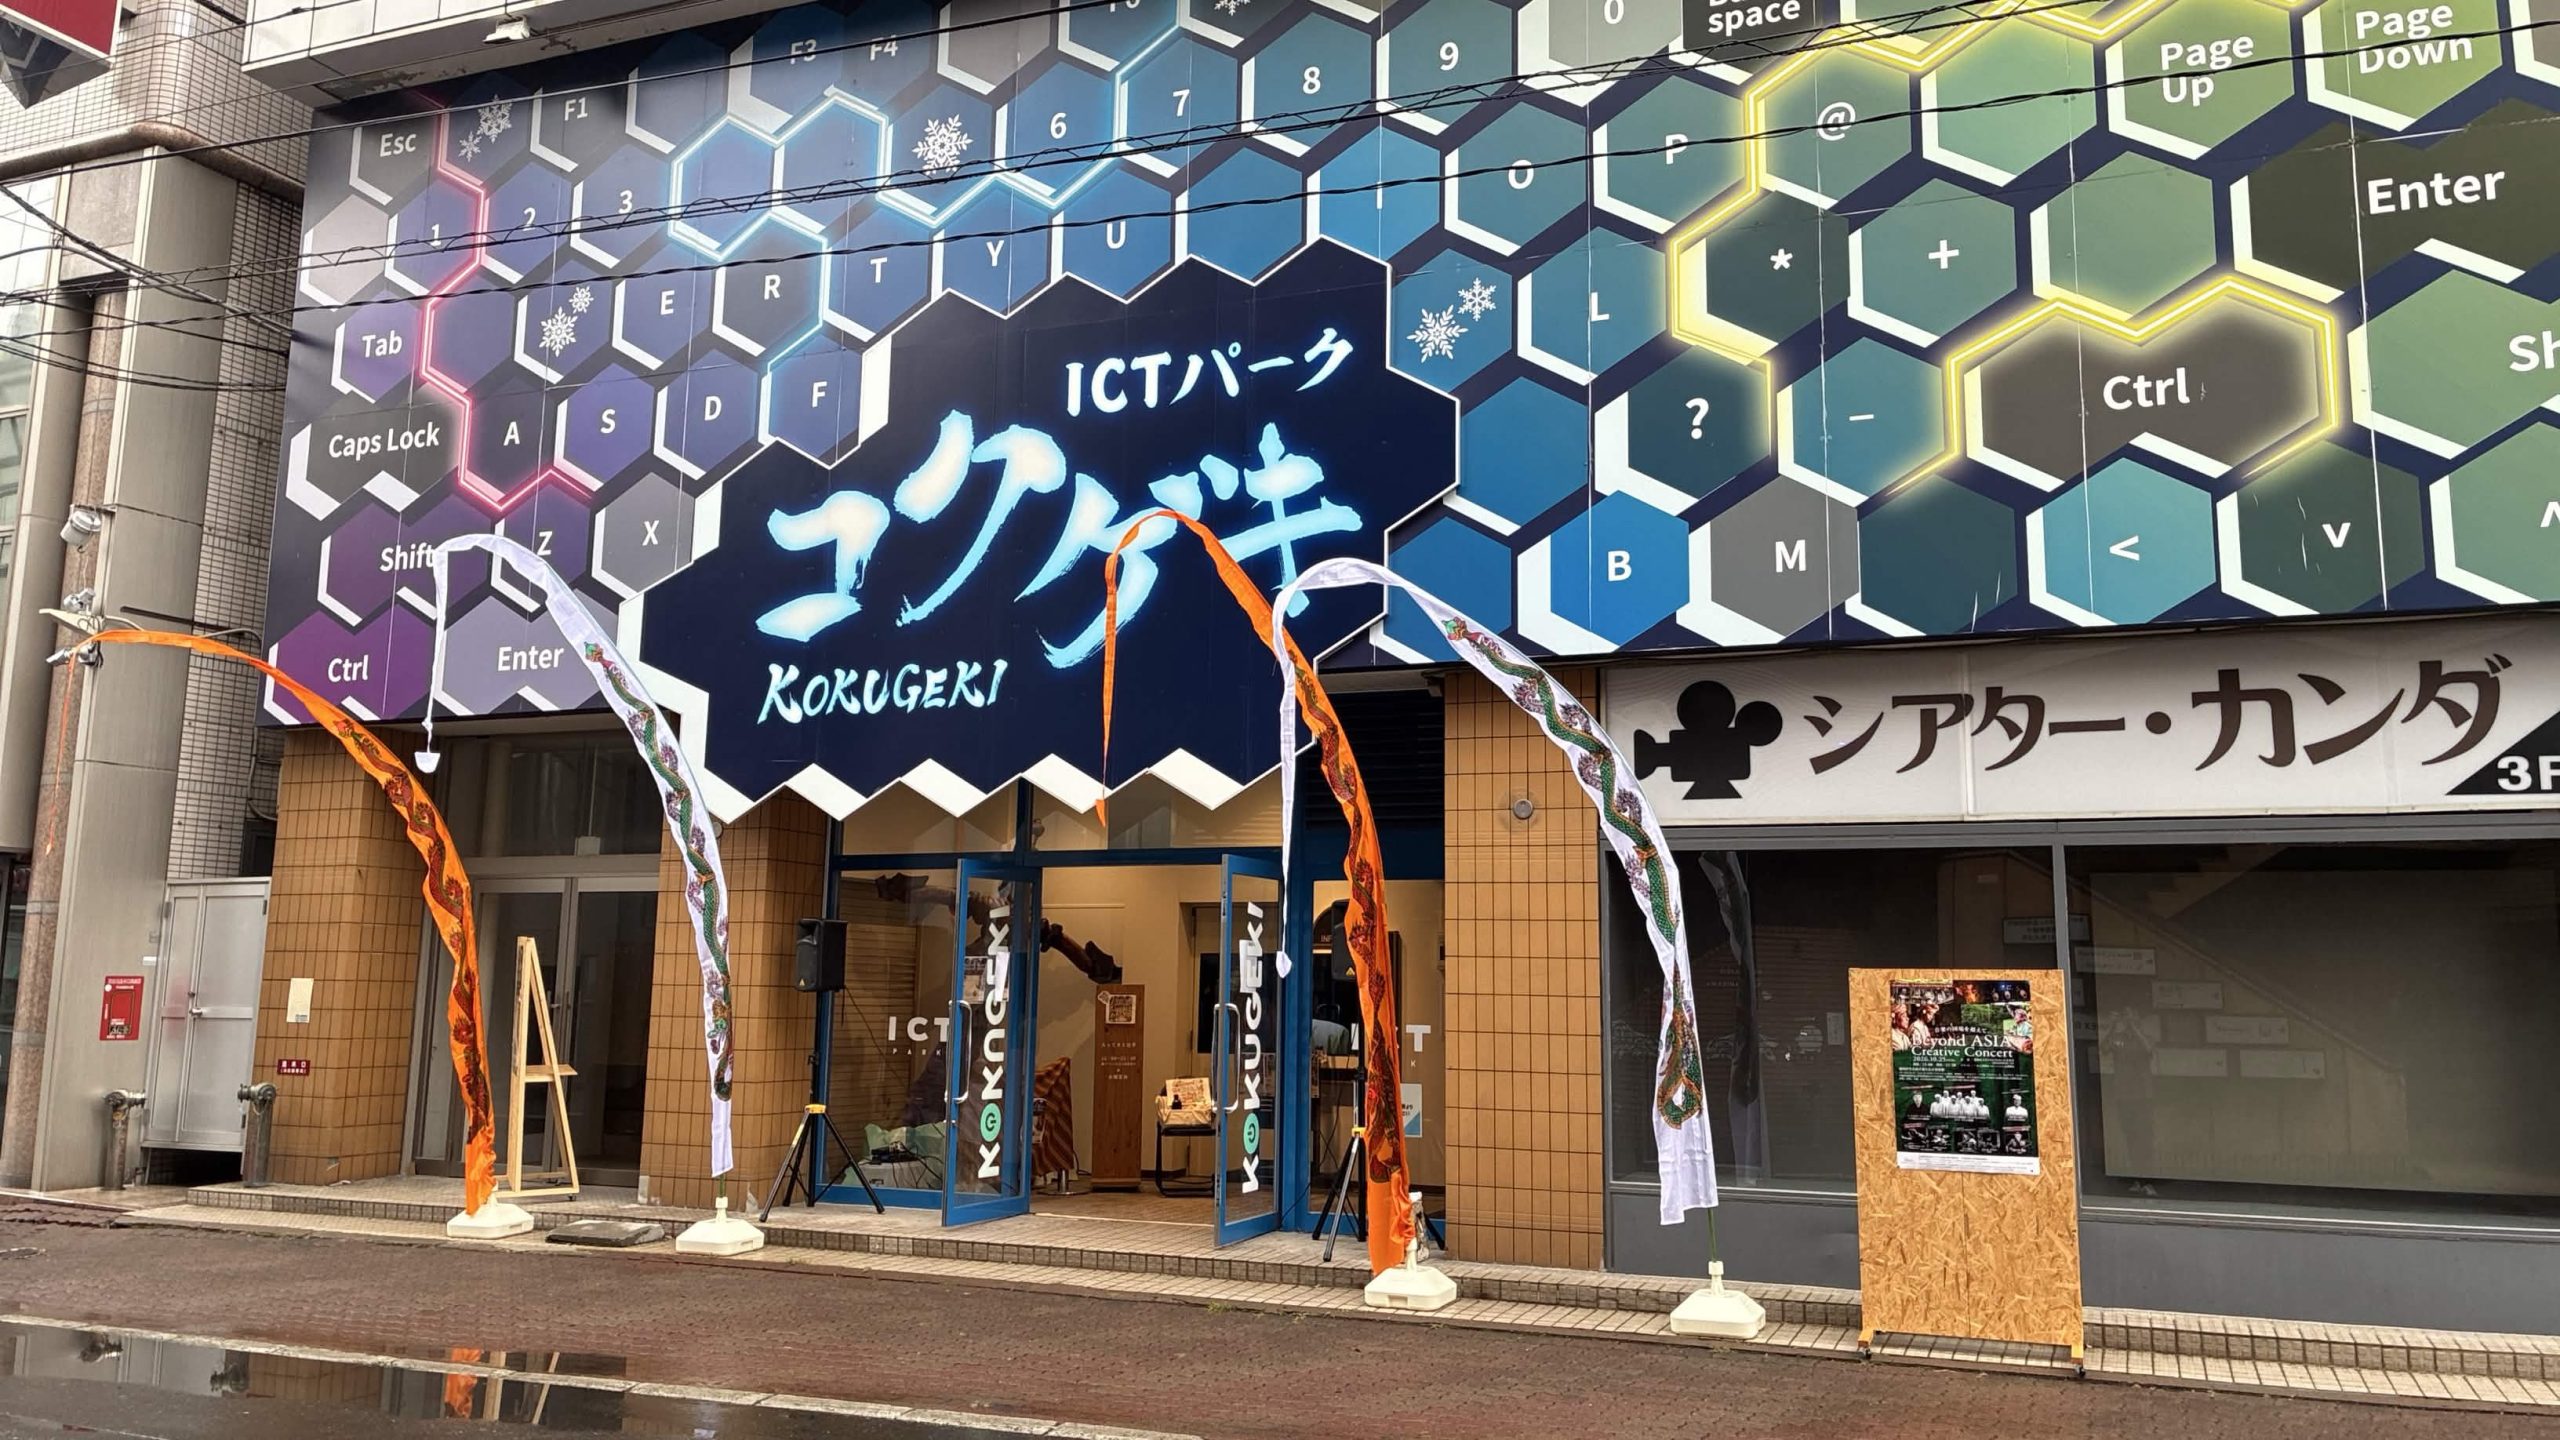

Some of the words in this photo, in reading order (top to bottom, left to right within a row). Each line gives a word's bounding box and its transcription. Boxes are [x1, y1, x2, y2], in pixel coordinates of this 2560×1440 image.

[1708, 1, 1800, 36] space
[2355, 4, 2453, 40] Page
[789, 39, 817, 64] F3
[870, 38, 898, 61] F4
[1439, 42, 1459, 71] 9
[2160, 35, 2254, 71] Page
[2358, 37, 2473, 74] Down
[1303, 66, 1321, 94] 8
[2162, 76, 2214, 107] Up
[564, 97, 588, 121] F1
[1173, 90, 1190, 117] 7
[1050, 112, 1067, 138] 6
[1817, 102, 1856, 141] @
[380, 133, 417, 157] Esc
[1665, 134, 1689, 164] P
[1508, 160, 1534, 190] O
[618, 189, 633, 214] 3
[2367, 170, 2505, 215] Enter
[522, 207, 536, 231] 2
[430, 223, 442, 247] 1
[1106, 220, 1126, 249] U
[986, 239, 1005, 267] Y
[870, 258, 888, 283] T
[764, 275, 781, 299] R
[660, 291, 675, 315] E
[1590, 292, 1610, 322] L
[361, 333, 403, 358] Tab
[1065, 327, 1354, 417] ICTパーク
[812, 382, 828, 408] F
[2103, 367, 2191, 410] Ctrl
[601, 409, 616, 434] S
[705, 395, 722, 421] D
[1685, 397, 1710, 440] ?
[328, 434, 382, 461] Caps
[387, 421, 440, 452] Lock
[503, 421, 520, 446] A
[537, 530, 553, 557] Z
[642, 520, 660, 546] X
[379, 542, 434, 573] Shift
[1607, 550, 1632, 582] B
[1775, 539, 1807, 573] M
[327, 654, 369, 682] Ctrl
[497, 645, 565, 672] Enter
[757, 658, 1008, 725] KOKUGEKI
[1804, 653, 2513, 776] シアター・カンダ
[2497, 755, 2560, 791] 3F
[888, 1016, 950, 1042] ICT
[1912, 1033, 1966, 1050] Beyond
[1971, 1034, 2012, 1048] ASIA
[1911, 1046, 1961, 1057] Creative
[1964, 1046, 2014, 1058] Concert
